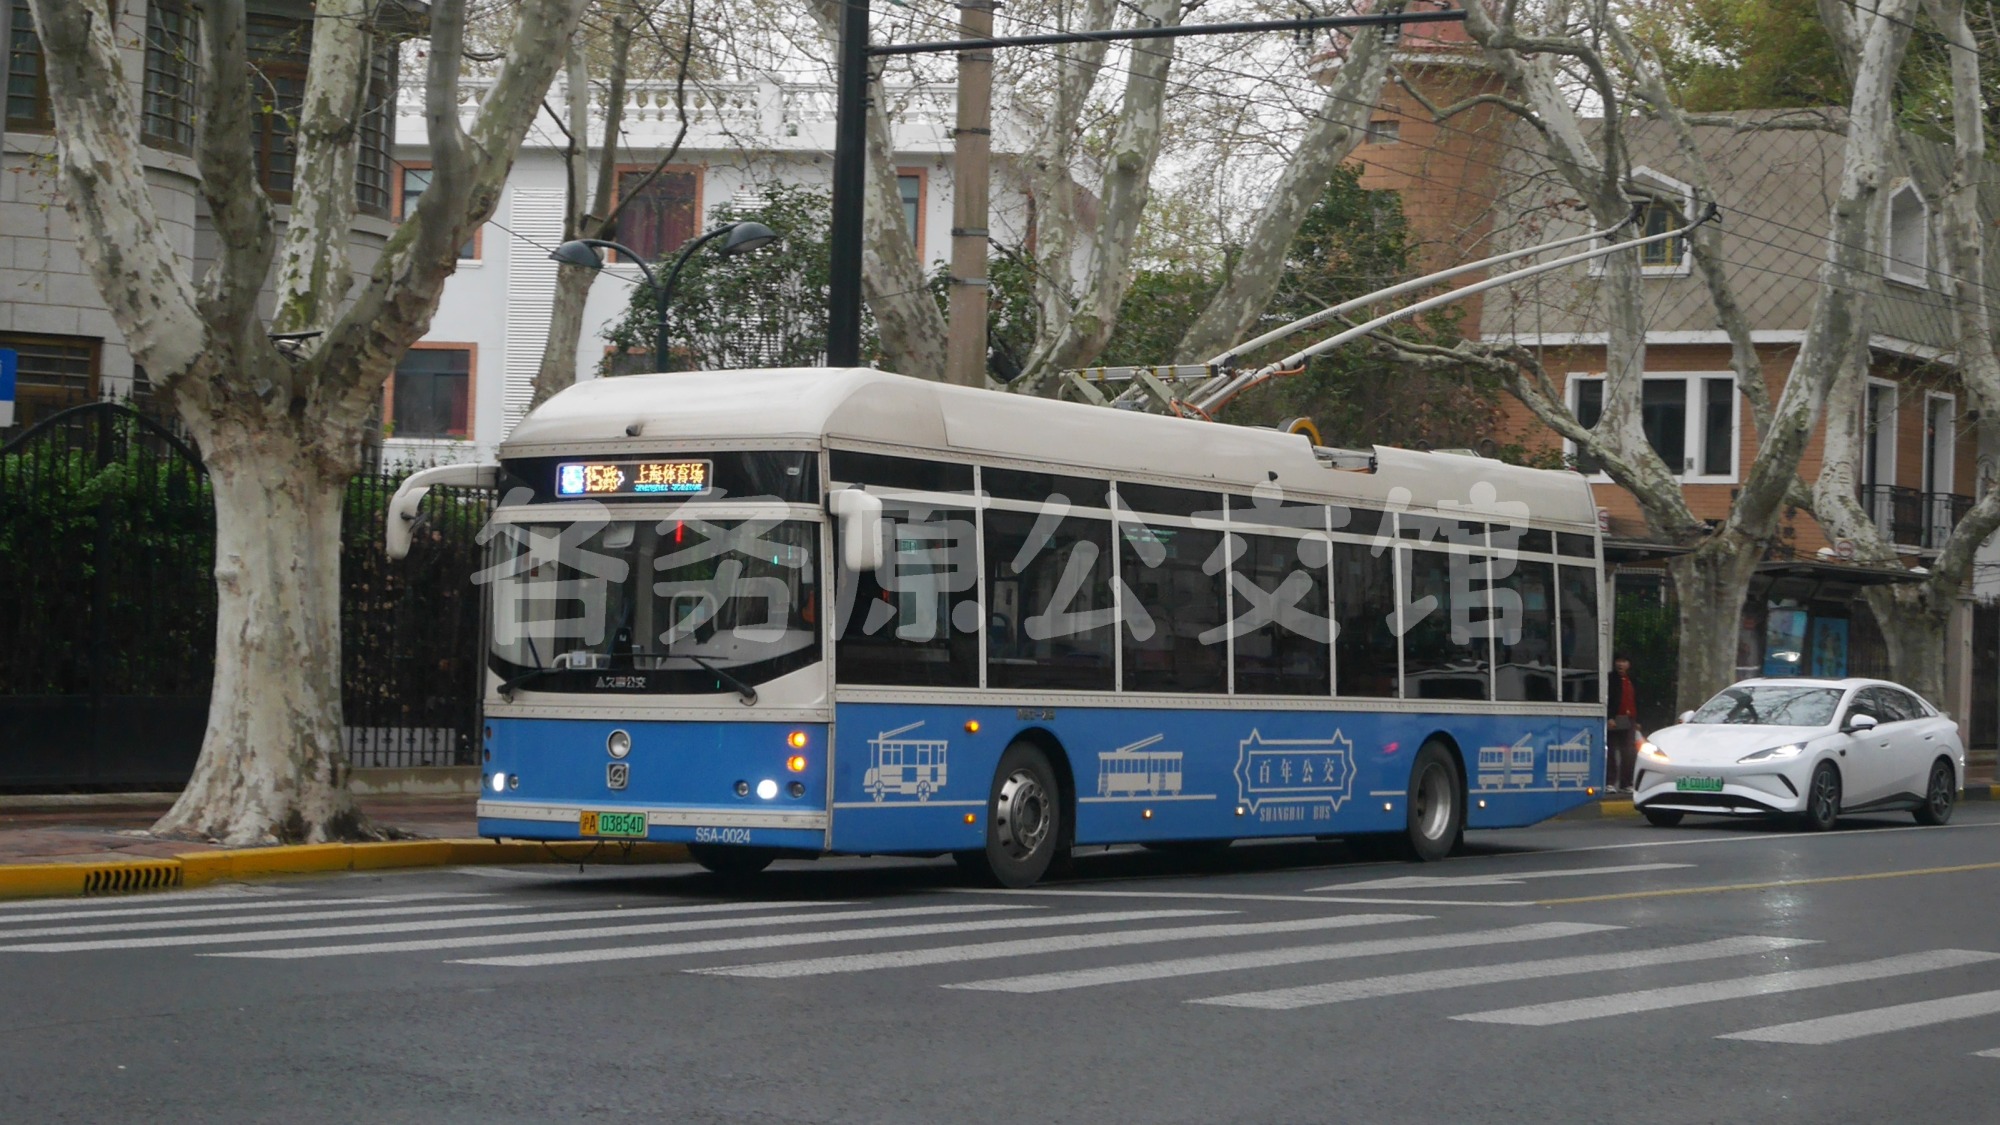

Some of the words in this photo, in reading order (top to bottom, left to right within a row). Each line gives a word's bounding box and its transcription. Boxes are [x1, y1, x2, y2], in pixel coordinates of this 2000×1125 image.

[1260, 758, 1334, 784] 百年公交
[1260, 806, 1304, 822] SHANGHAI
[1313, 805, 1331, 820] BUS
[601, 815, 644, 834] 03854D
[695, 827, 751, 844] S5A-0024
